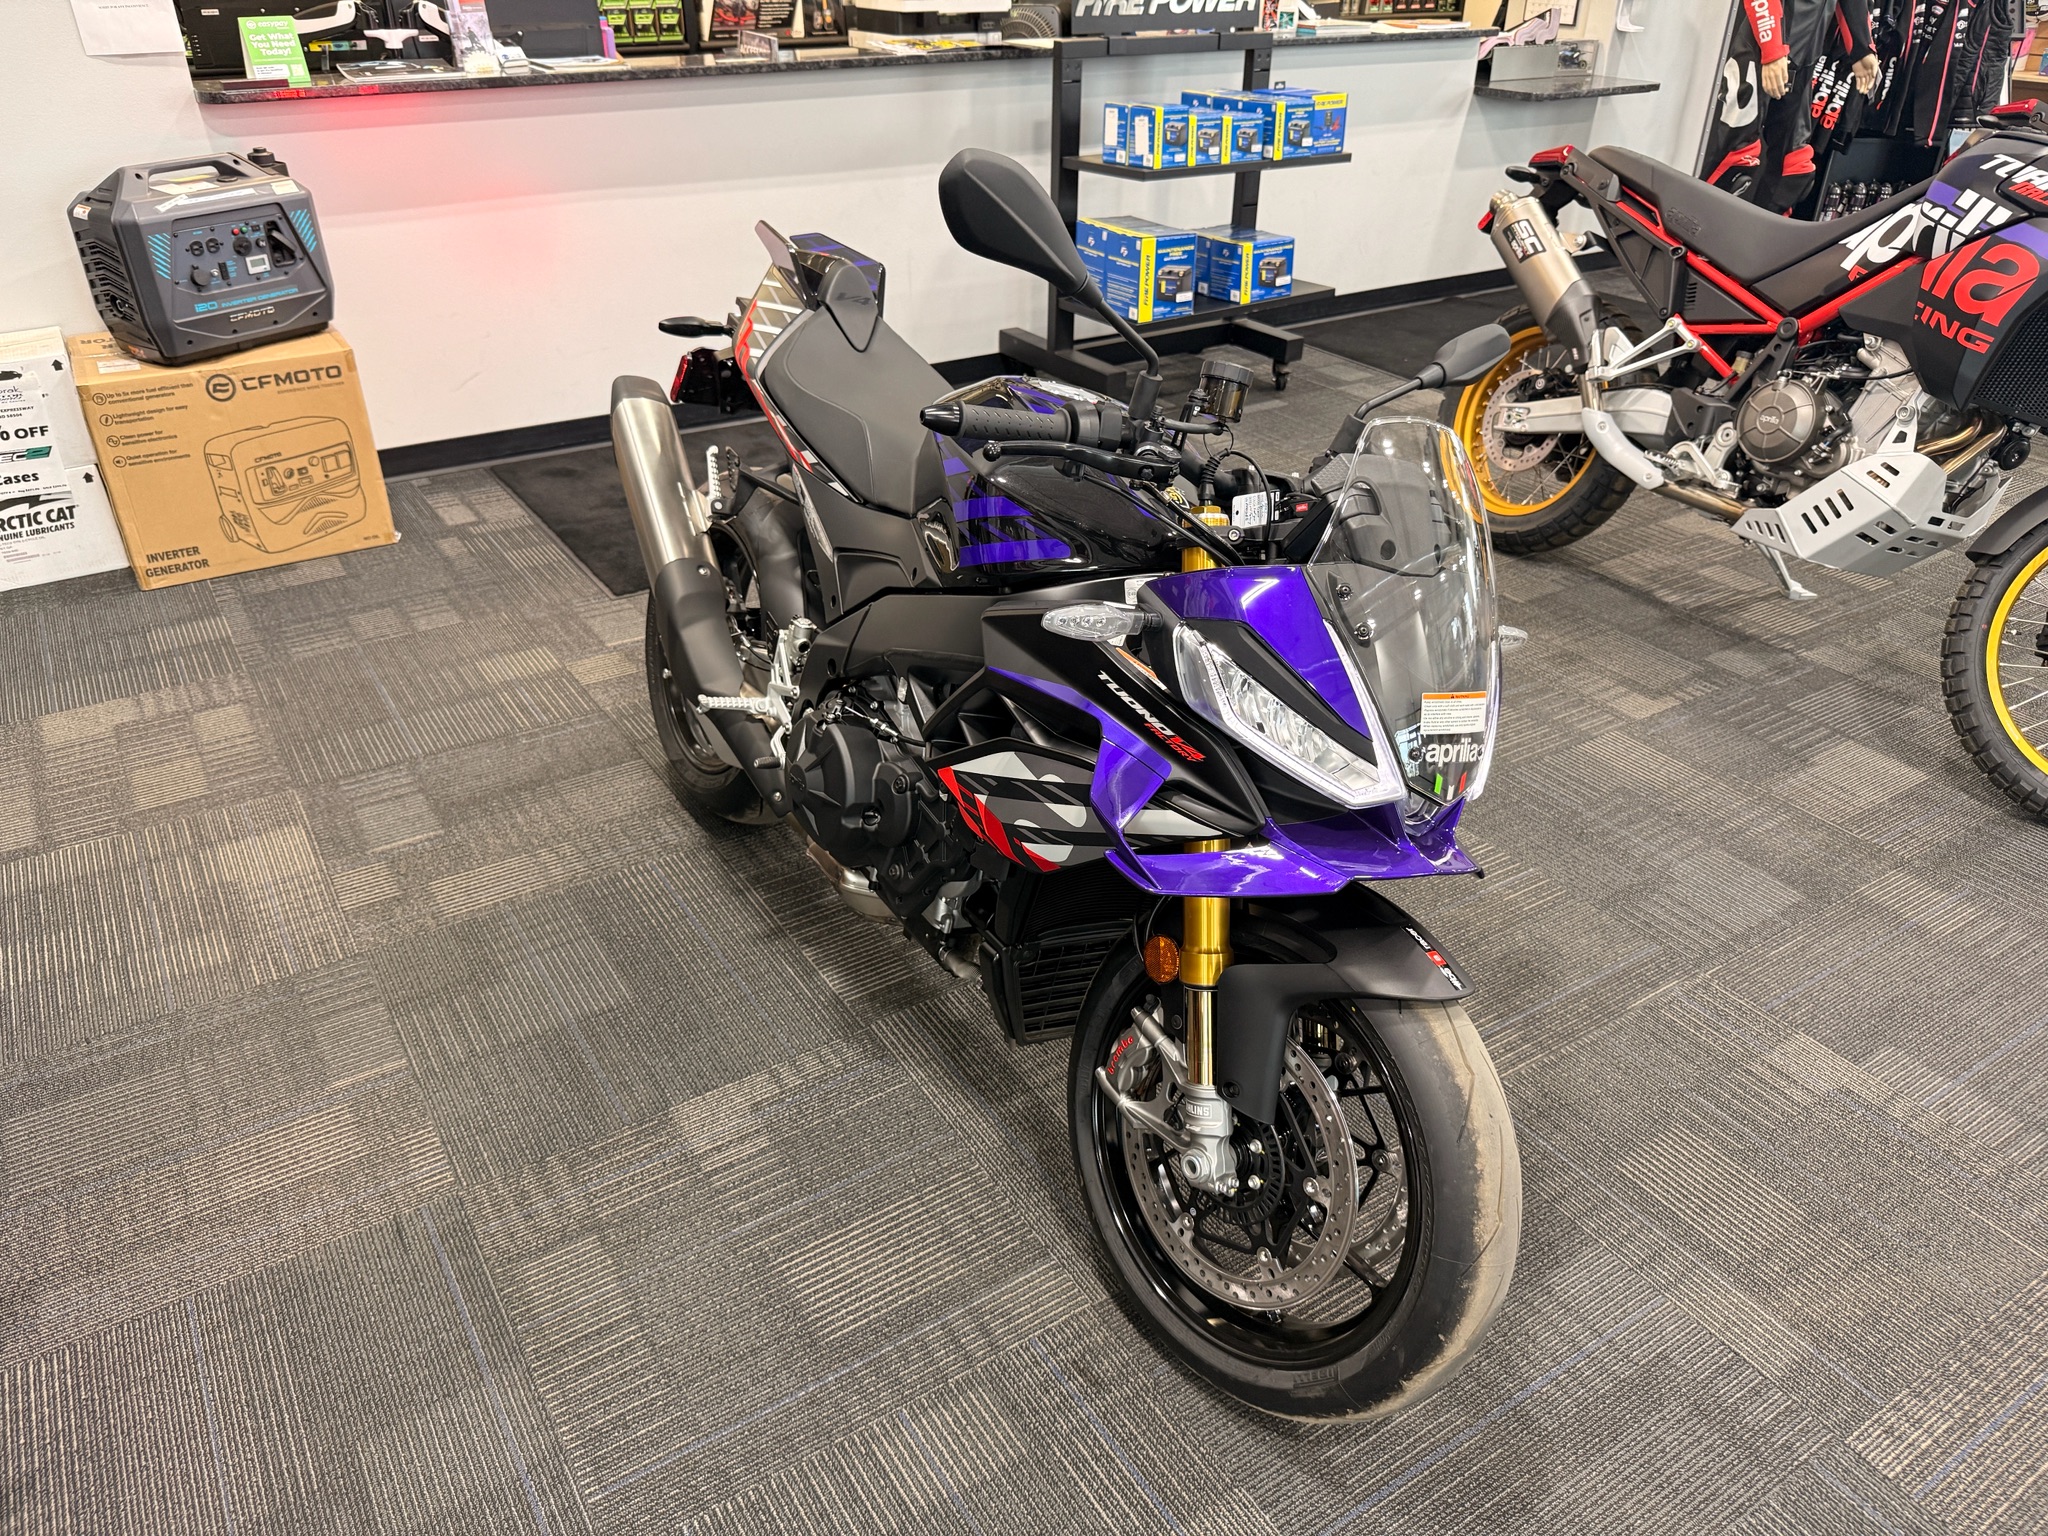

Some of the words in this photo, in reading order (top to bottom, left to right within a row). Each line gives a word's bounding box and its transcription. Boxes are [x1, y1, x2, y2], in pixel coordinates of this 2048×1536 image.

[1751, 0, 1776, 44] prilia
[260, 48, 292, 56] Today!
[2008, 181, 2048, 207] RAL
[229, 306, 275, 322] CFMOTO
[241, 365, 342, 391] CFMOTO
[113, 410, 146, 420] Lightweight
[146, 408, 166, 416] design
[14, 425, 49, 439] OFF
[46, 505, 76, 524] CAT
[25, 521, 75, 537] LUBRICANTS
[146, 546, 200, 564] INVERTER
[145, 558, 210, 579] GENERATOR
[1097, 670, 1176, 736] TUONO
[1144, 722, 1205, 762] FACTORY
[1425, 737, 1479, 768] aprilia
[1106, 1036, 1134, 1075] brembo
